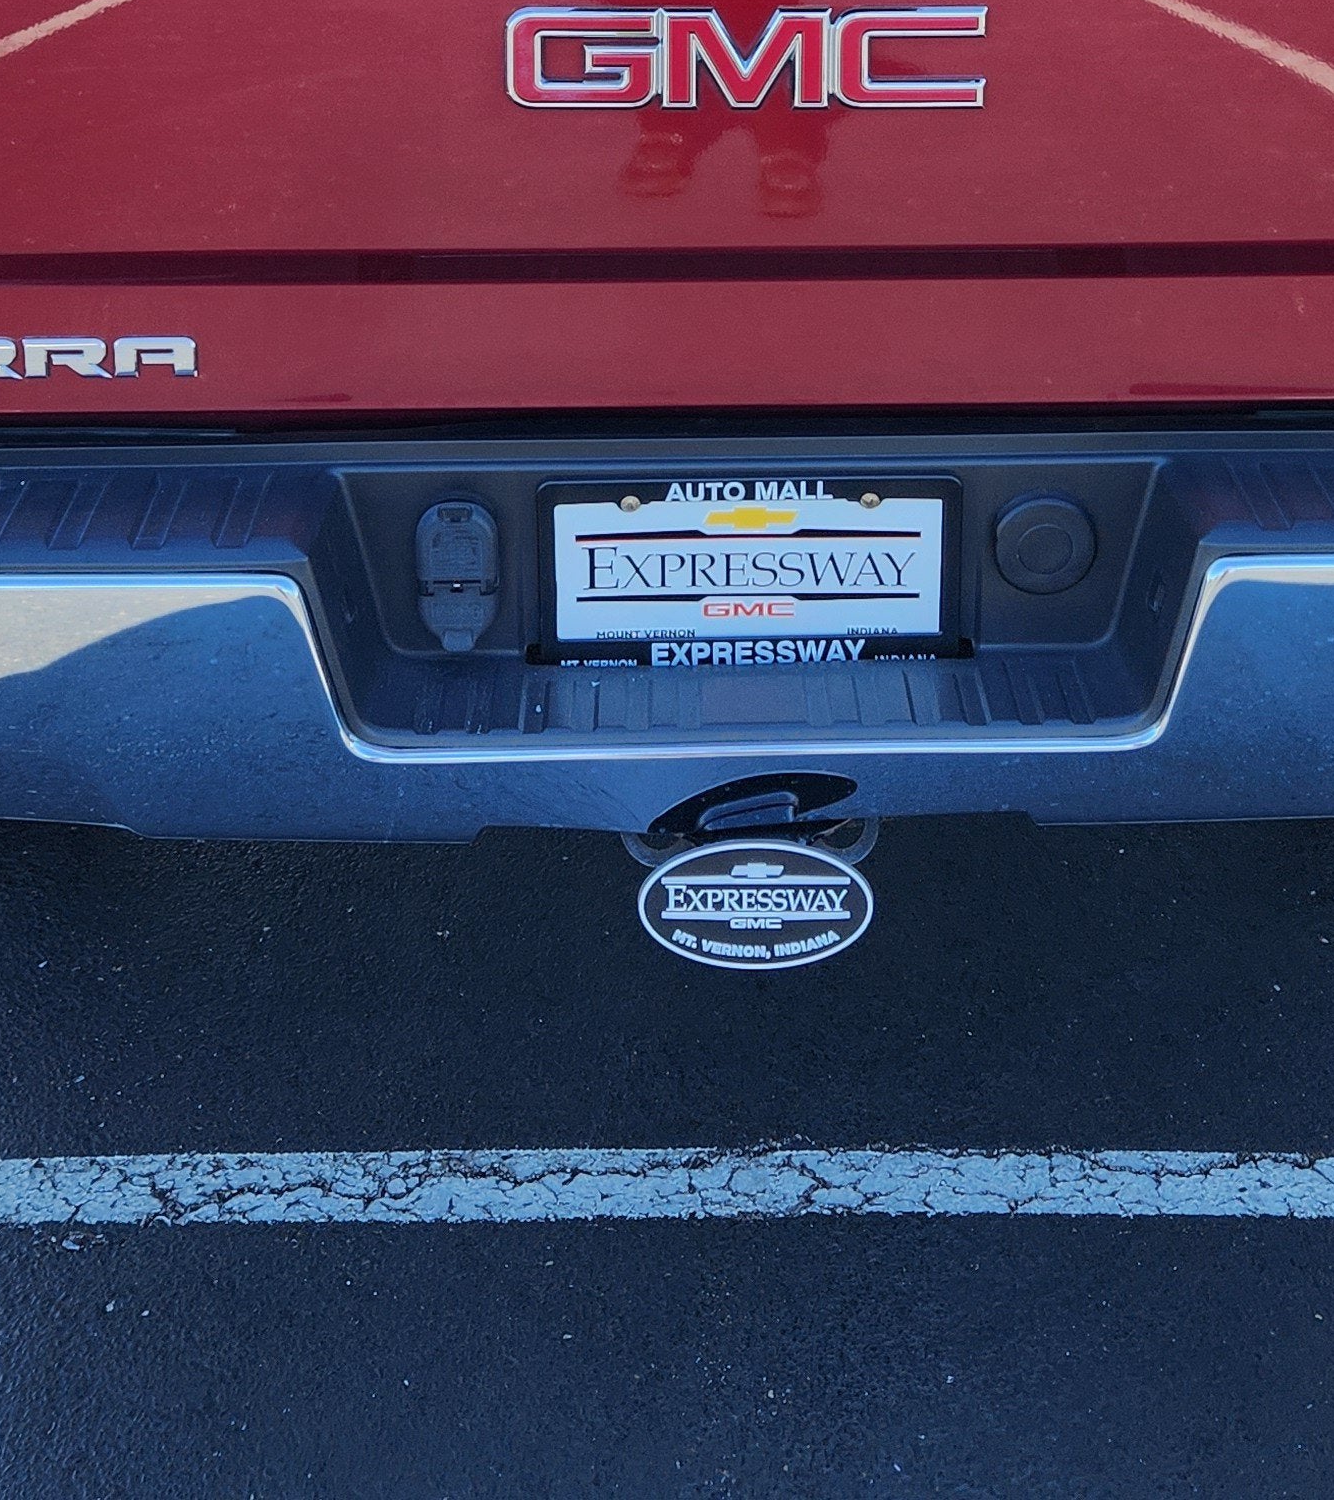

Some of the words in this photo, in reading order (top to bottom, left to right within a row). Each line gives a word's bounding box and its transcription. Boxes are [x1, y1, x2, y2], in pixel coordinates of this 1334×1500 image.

[505, 5, 988, 109] GMC
[665, 481, 746, 503] AUTO
[755, 480, 834, 501] MALL
[582, 545, 916, 591] EXPRESSWAY
[703, 602, 795, 618] GMC
[596, 629, 641, 640] MOUNT
[645, 628, 696, 639] VERNON
[847, 627, 899, 636] INDIANA
[651, 639, 866, 667] EXPRESSWAY
[665, 884, 848, 912] EXPRESSWAY
[729, 918, 783, 930] GMC
[671, 928, 698, 950] MT.
[701, 938, 772, 960] VERNON,
[774, 929, 841, 957] INDIANA
